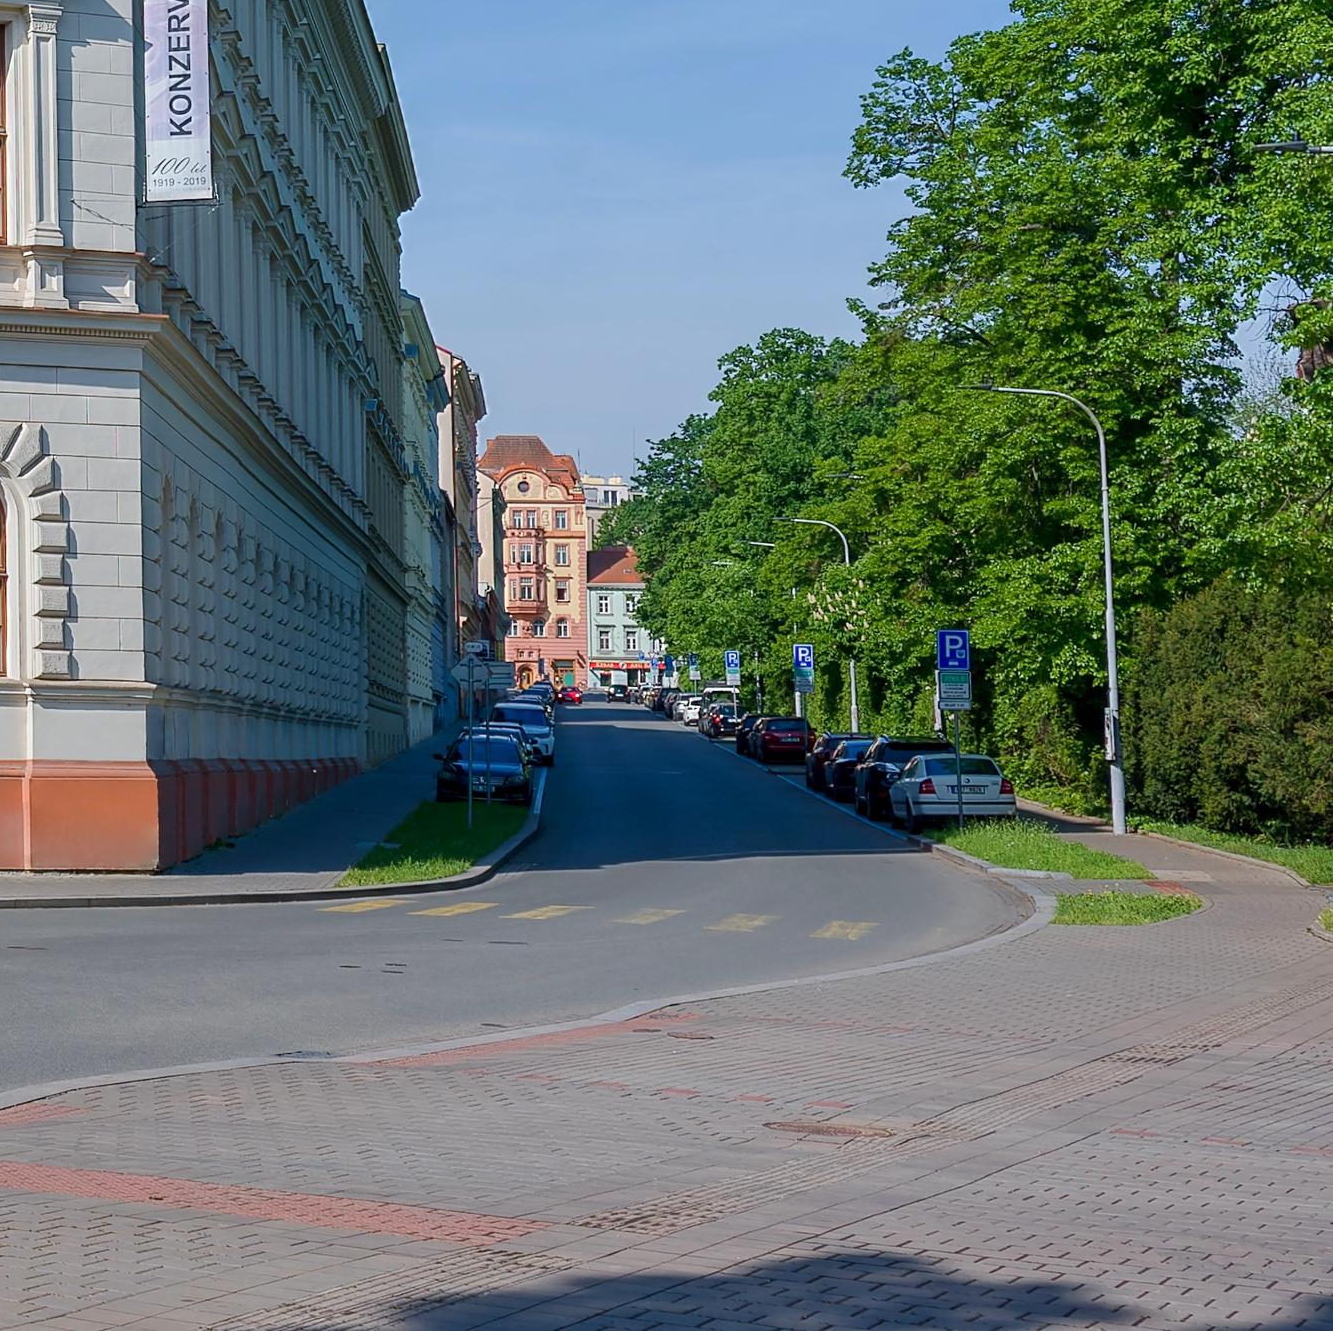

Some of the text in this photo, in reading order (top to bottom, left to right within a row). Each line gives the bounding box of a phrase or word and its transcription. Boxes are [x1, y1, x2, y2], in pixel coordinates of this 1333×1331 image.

[152, 157, 190, 175] 100
[153, 178, 175, 187] 1919
[183, 177, 206, 186] 2019
